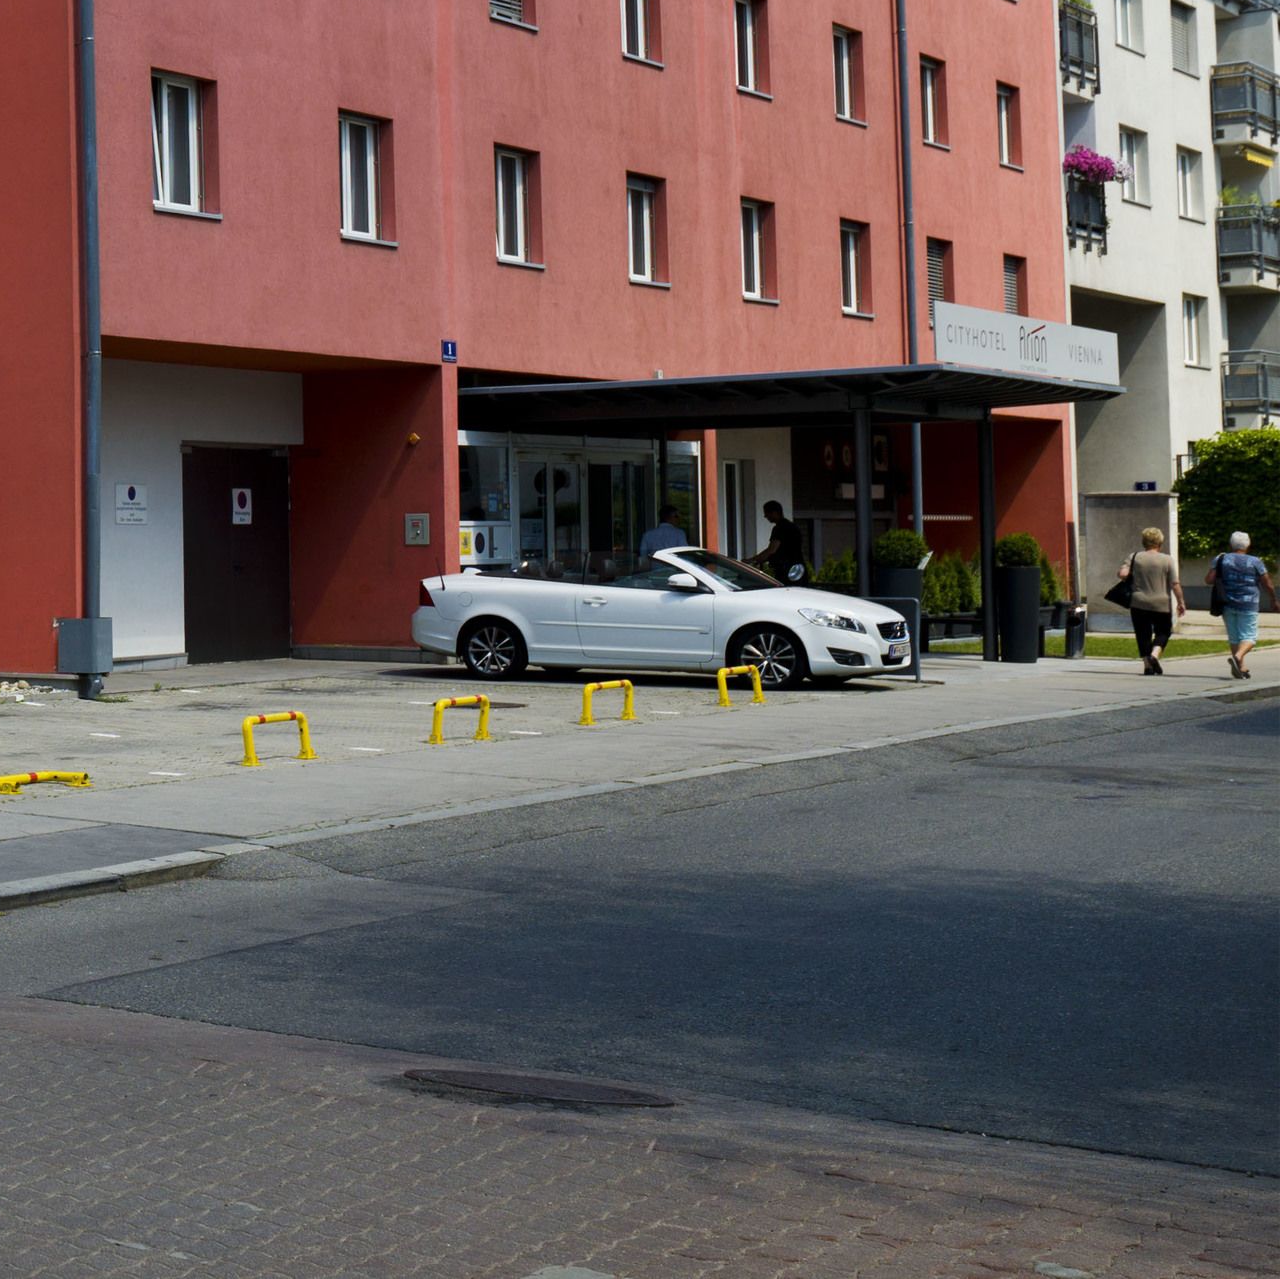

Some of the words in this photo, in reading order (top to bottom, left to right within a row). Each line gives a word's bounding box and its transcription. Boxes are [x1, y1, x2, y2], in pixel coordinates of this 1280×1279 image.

[946, 323, 1007, 352] CITYHOTEL
[1019, 324, 1048, 364] Arion
[1068, 343, 1104, 366] VIENNA
